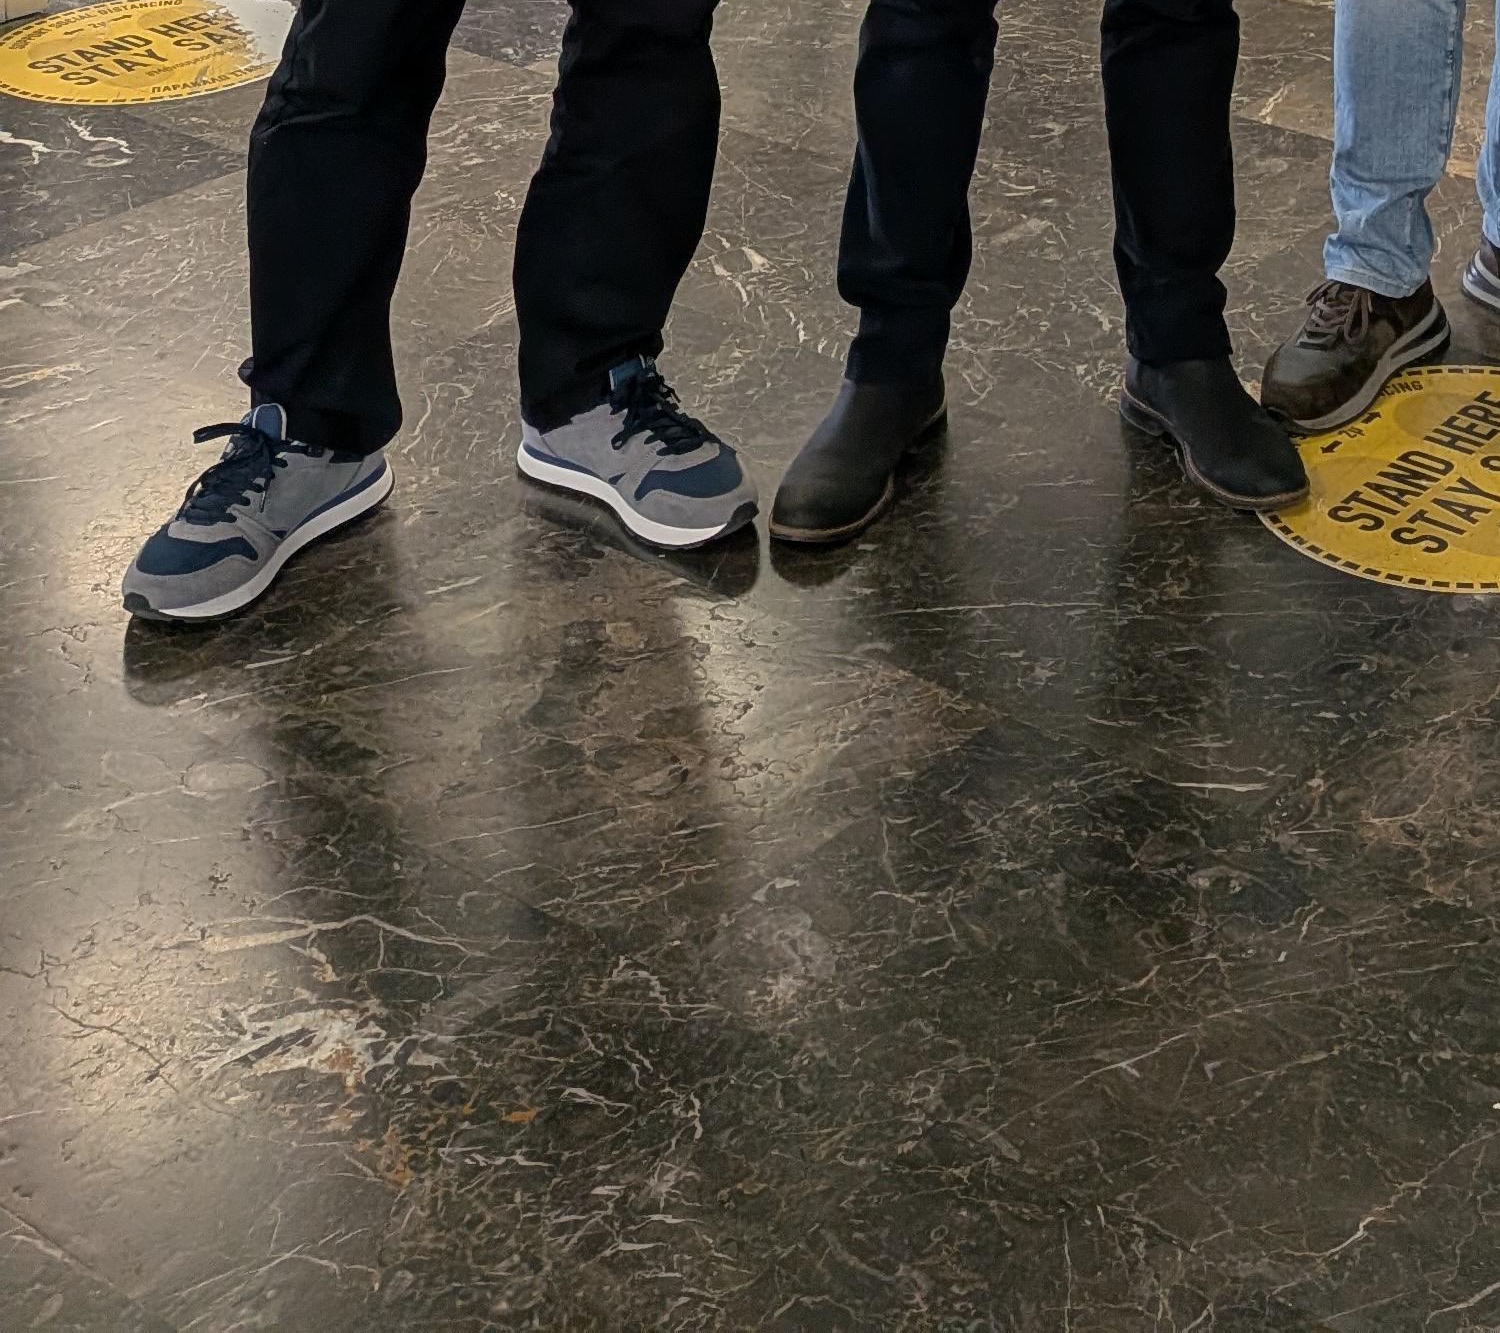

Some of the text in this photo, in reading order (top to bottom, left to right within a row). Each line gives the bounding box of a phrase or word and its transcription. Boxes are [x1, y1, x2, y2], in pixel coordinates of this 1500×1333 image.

[98, 0, 183, 15] DISTANCING
[28, 35, 152, 74] STAND
[147, 11, 240, 38] HER
[60, 48, 168, 85] STAY
[1327, 450, 1455, 531] STAND
